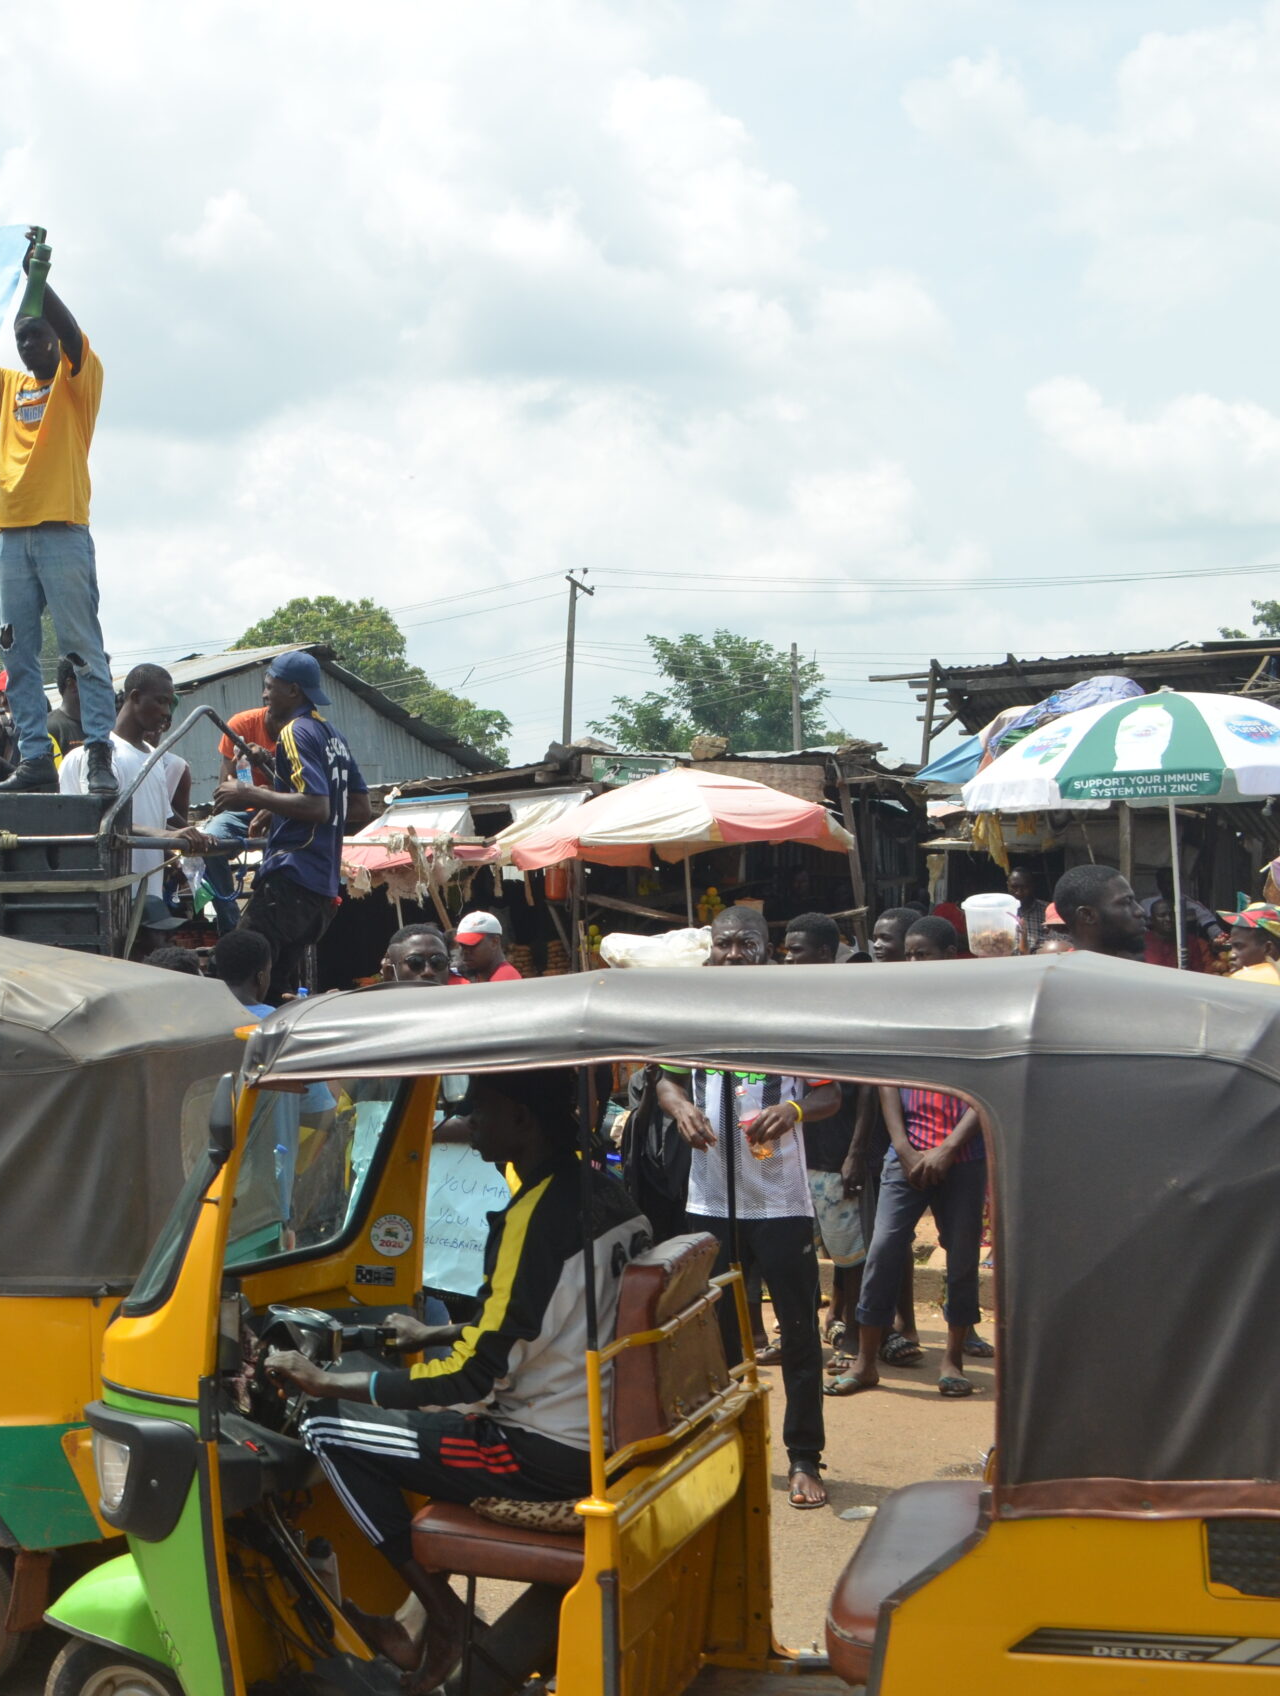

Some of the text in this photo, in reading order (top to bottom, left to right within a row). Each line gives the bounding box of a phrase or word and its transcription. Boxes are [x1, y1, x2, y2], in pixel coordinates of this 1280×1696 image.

[1074, 773, 1210, 789] SUPPORT YOUR IMMUNE
[1090, 783, 1198, 797] SYSTEM WITH ZINC
[379, 1239, 405, 1249] 2020
[1092, 1646, 1190, 1660] DELUXE
